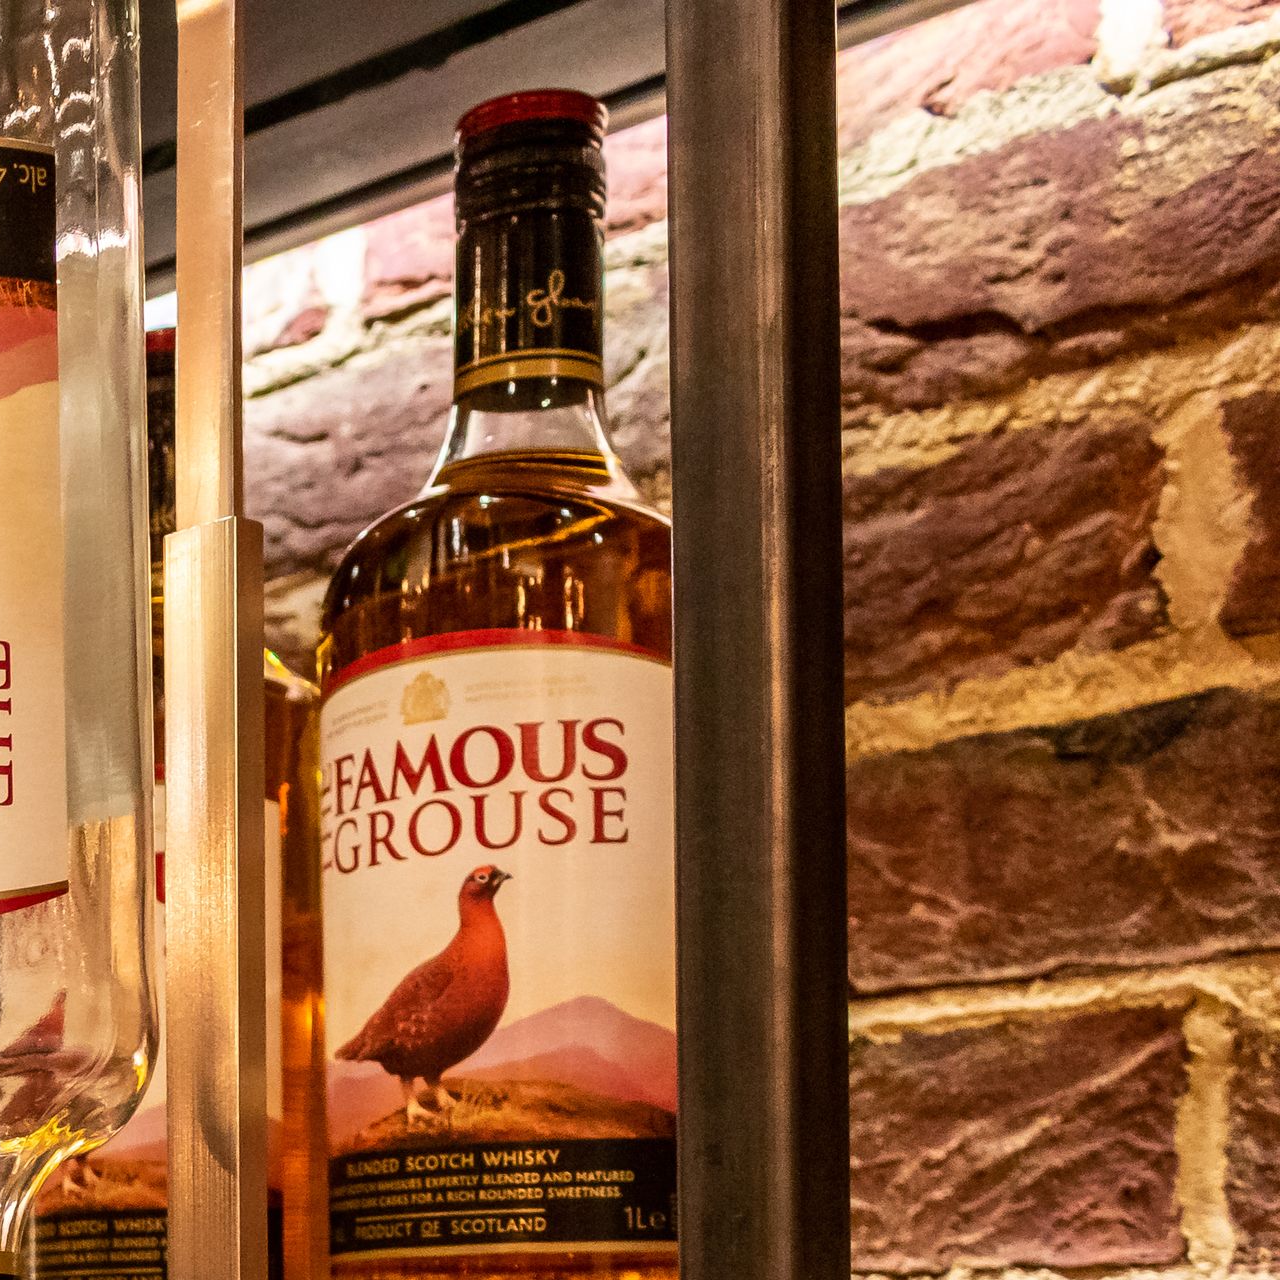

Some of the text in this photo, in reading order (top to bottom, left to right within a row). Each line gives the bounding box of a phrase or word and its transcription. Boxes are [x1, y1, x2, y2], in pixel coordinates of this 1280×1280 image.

[13, 162, 48, 193] alc.
[334, 716, 630, 818] FAMOUS
[333, 785, 630, 875] GROUSE
[346, 1149, 561, 1179] BLENDED SCOTCH WHISKY
[425, 1175, 479, 1189] EXPERTLY
[482, 1171, 541, 1186] BLENDED
[542, 1170, 573, 1183] AND
[575, 1169, 635, 1183] MATURED
[446, 1189, 476, 1202] RICH
[479, 1187, 544, 1201] ROUNDED
[113, 1217, 167, 1232] WHISK
[354, 1216, 547, 1240] PRODUCT OF SCOTLAND
